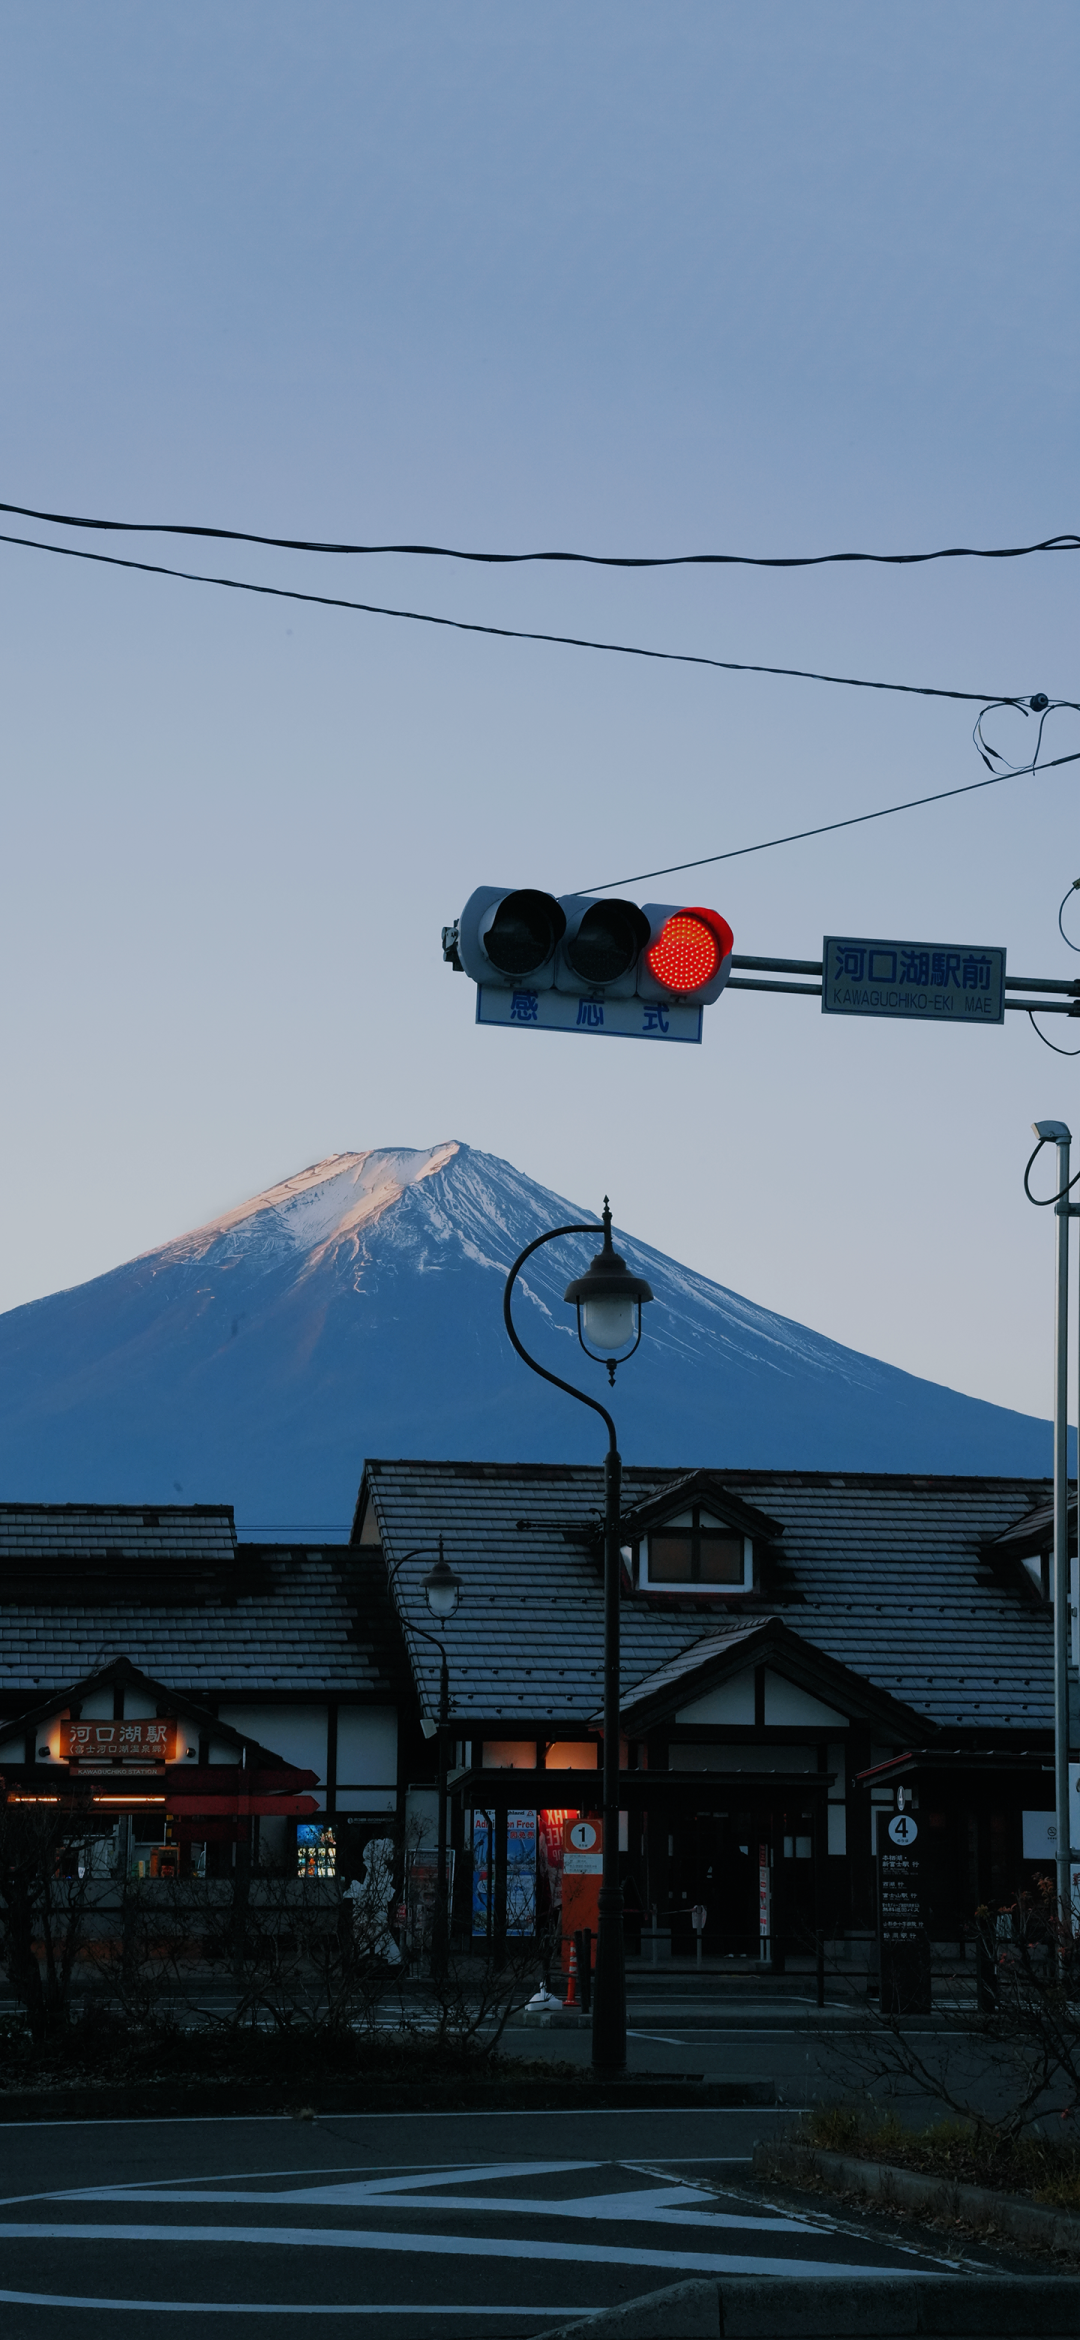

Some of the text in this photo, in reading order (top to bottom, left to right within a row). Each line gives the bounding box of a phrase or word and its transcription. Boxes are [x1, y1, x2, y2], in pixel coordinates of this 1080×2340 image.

[834, 945, 993, 991] 河口湖駅前
[833, 988, 992, 1013] KAWAGUCHIKO-EKI MAE
[69, 1725, 168, 1743] 河口湖駅
[516, 1820, 535, 1829] Free
[894, 1817, 909, 1838] 4
[578, 1826, 586, 1843] 1
